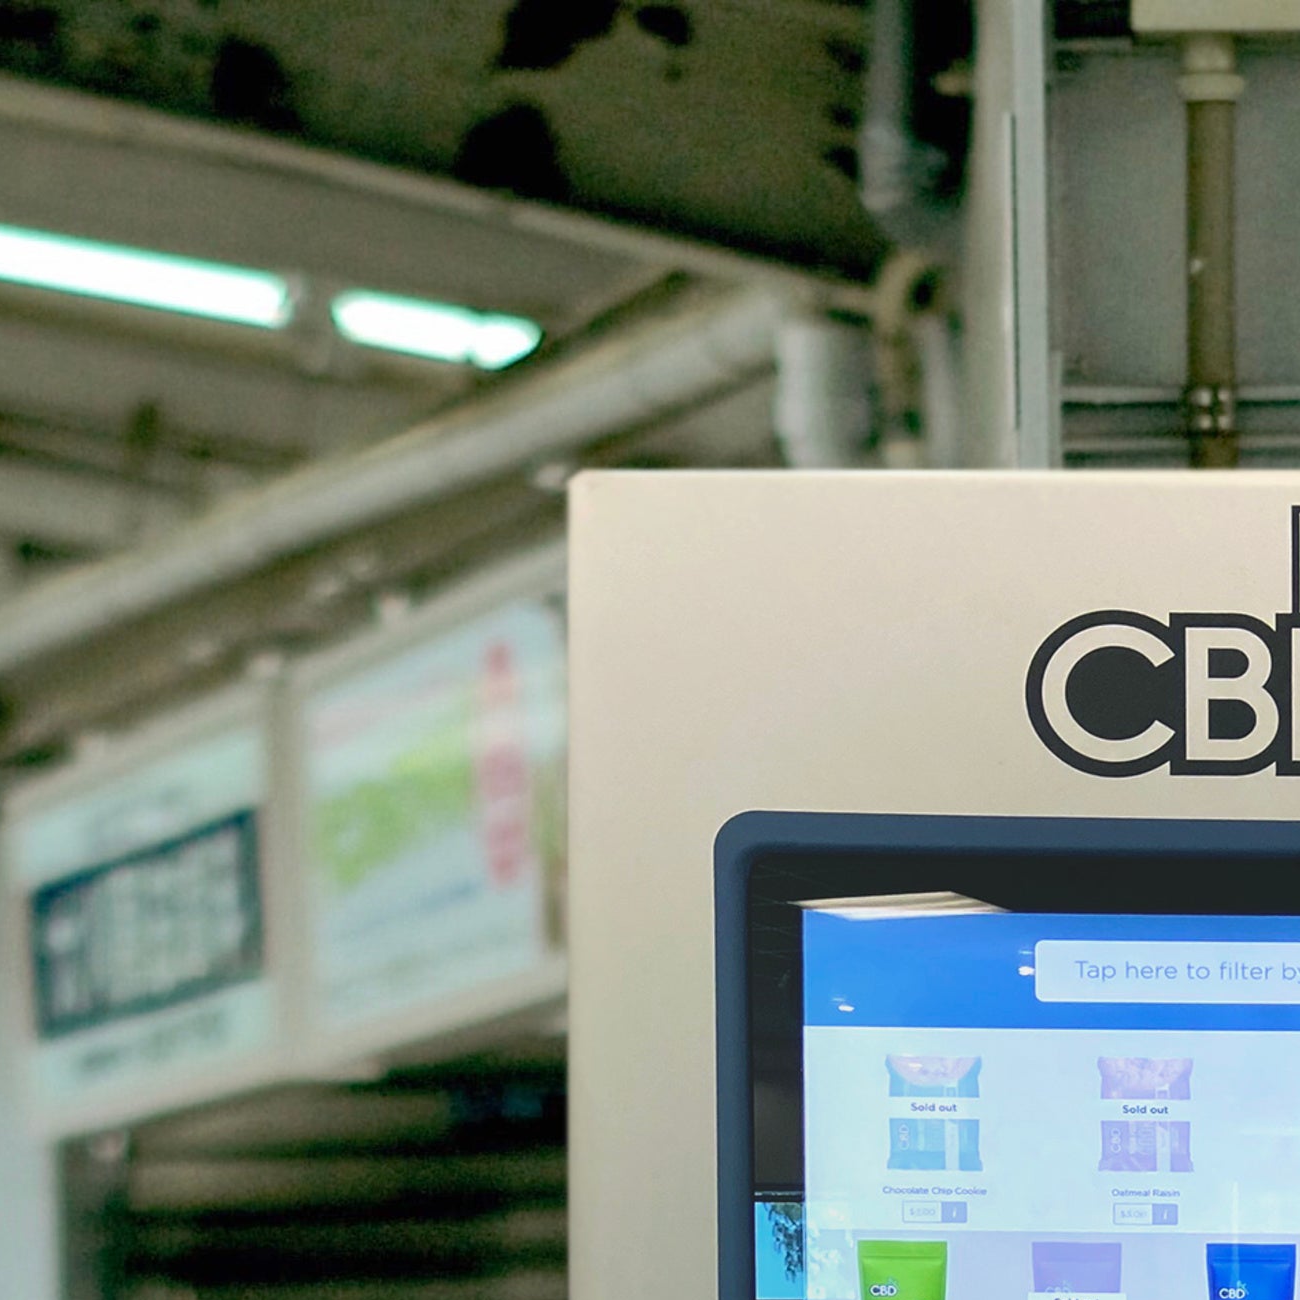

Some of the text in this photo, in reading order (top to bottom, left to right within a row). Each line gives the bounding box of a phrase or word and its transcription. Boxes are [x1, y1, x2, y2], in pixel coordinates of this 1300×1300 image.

[1075, 961, 1117, 983] Tap
[1126, 962, 1177, 980] here
[1187, 964, 1210, 980] to
[1220, 962, 1271, 981] filter
[911, 1103, 957, 1112] Sold out
[1123, 1105, 1168, 1114] Sold out
